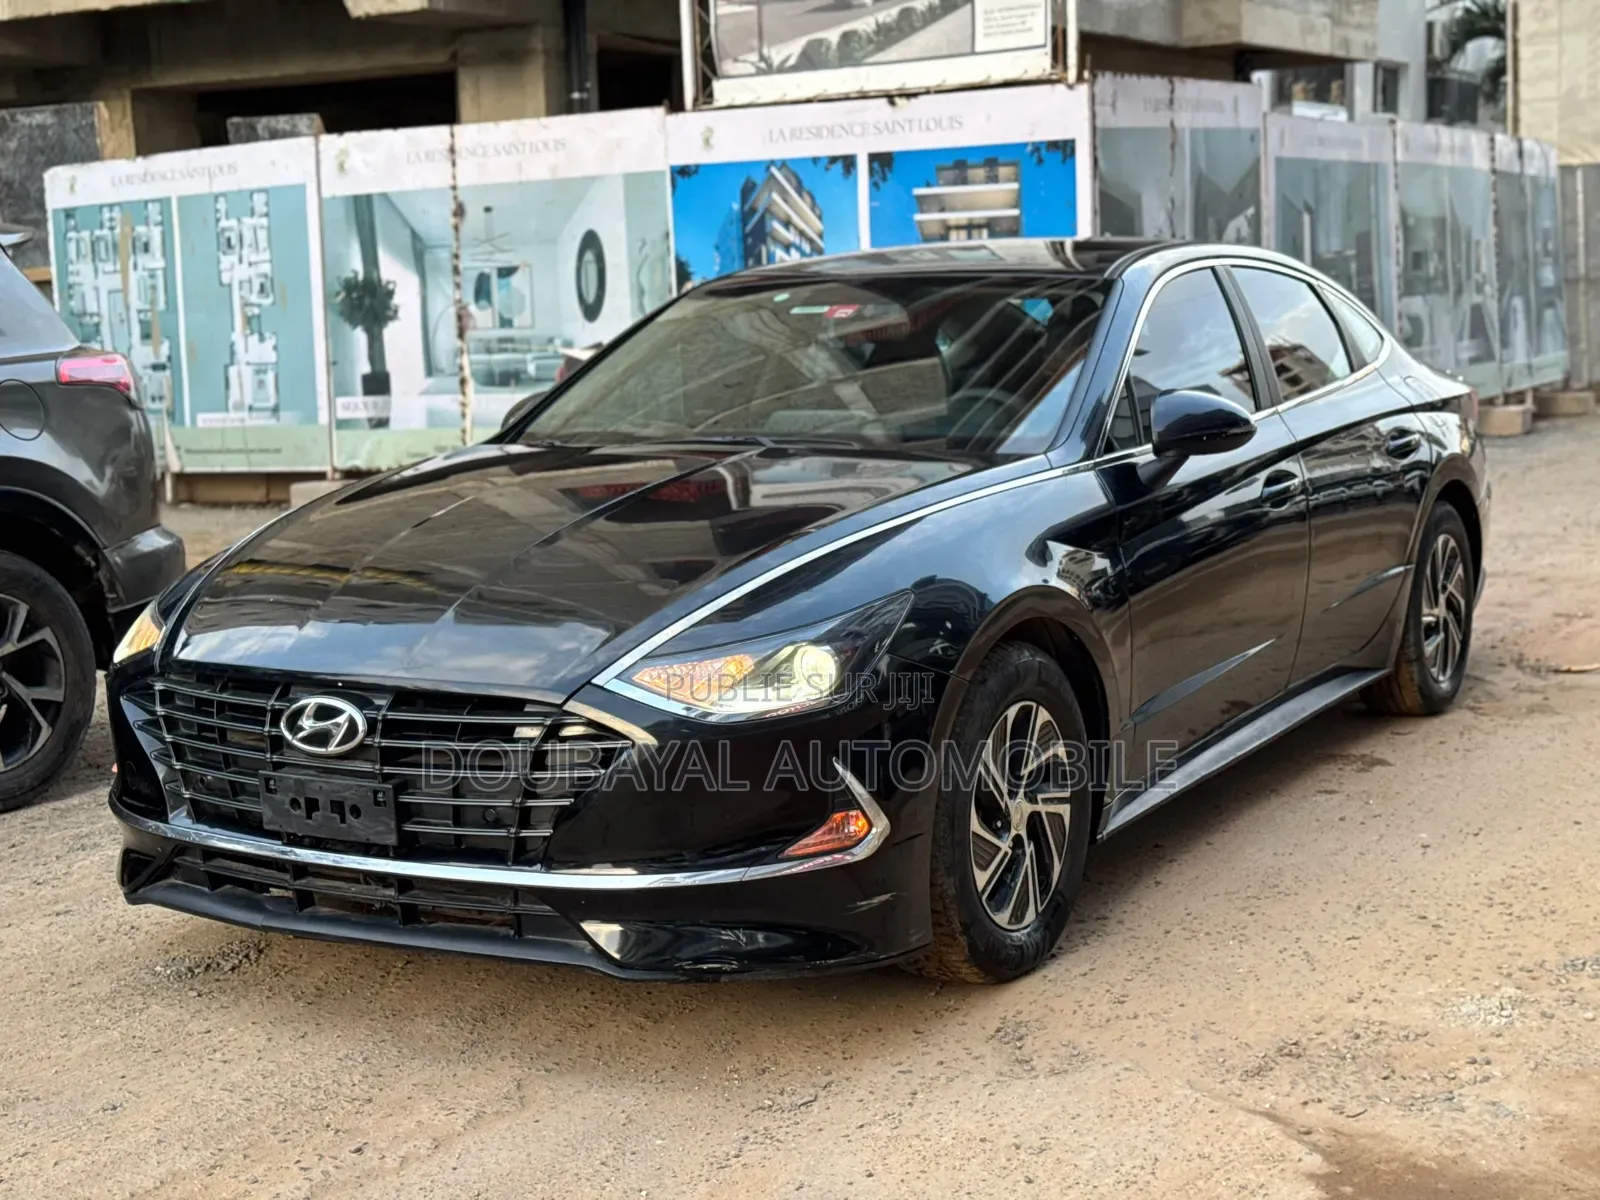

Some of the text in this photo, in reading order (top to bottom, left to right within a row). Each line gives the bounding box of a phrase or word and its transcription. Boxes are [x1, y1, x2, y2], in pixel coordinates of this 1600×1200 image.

[768, 115, 964, 144] LA RESIDENCE SAINT LOUIS
